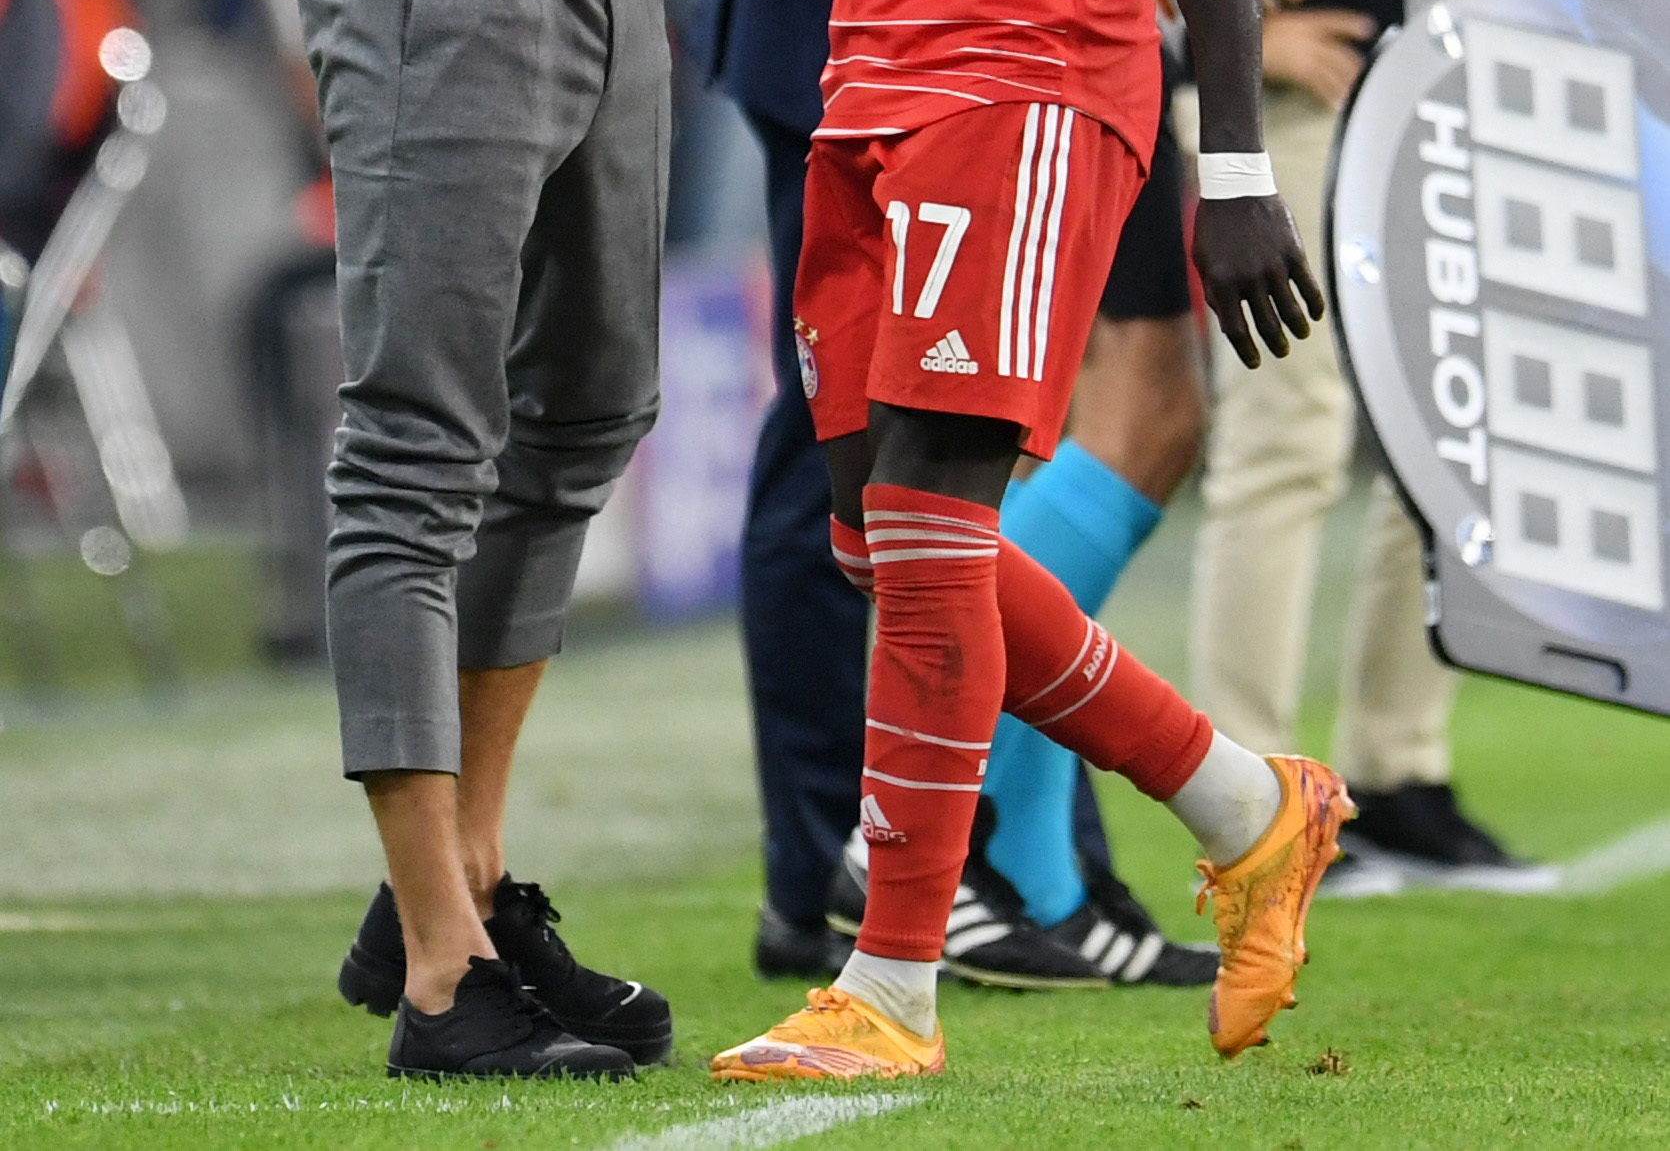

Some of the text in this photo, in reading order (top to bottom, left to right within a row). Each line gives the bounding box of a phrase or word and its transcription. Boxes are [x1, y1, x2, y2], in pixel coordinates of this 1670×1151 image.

[885, 200, 972, 319] 17
[1417, 99, 1488, 485] HUBLOT
[919, 356, 979, 375] adidas
